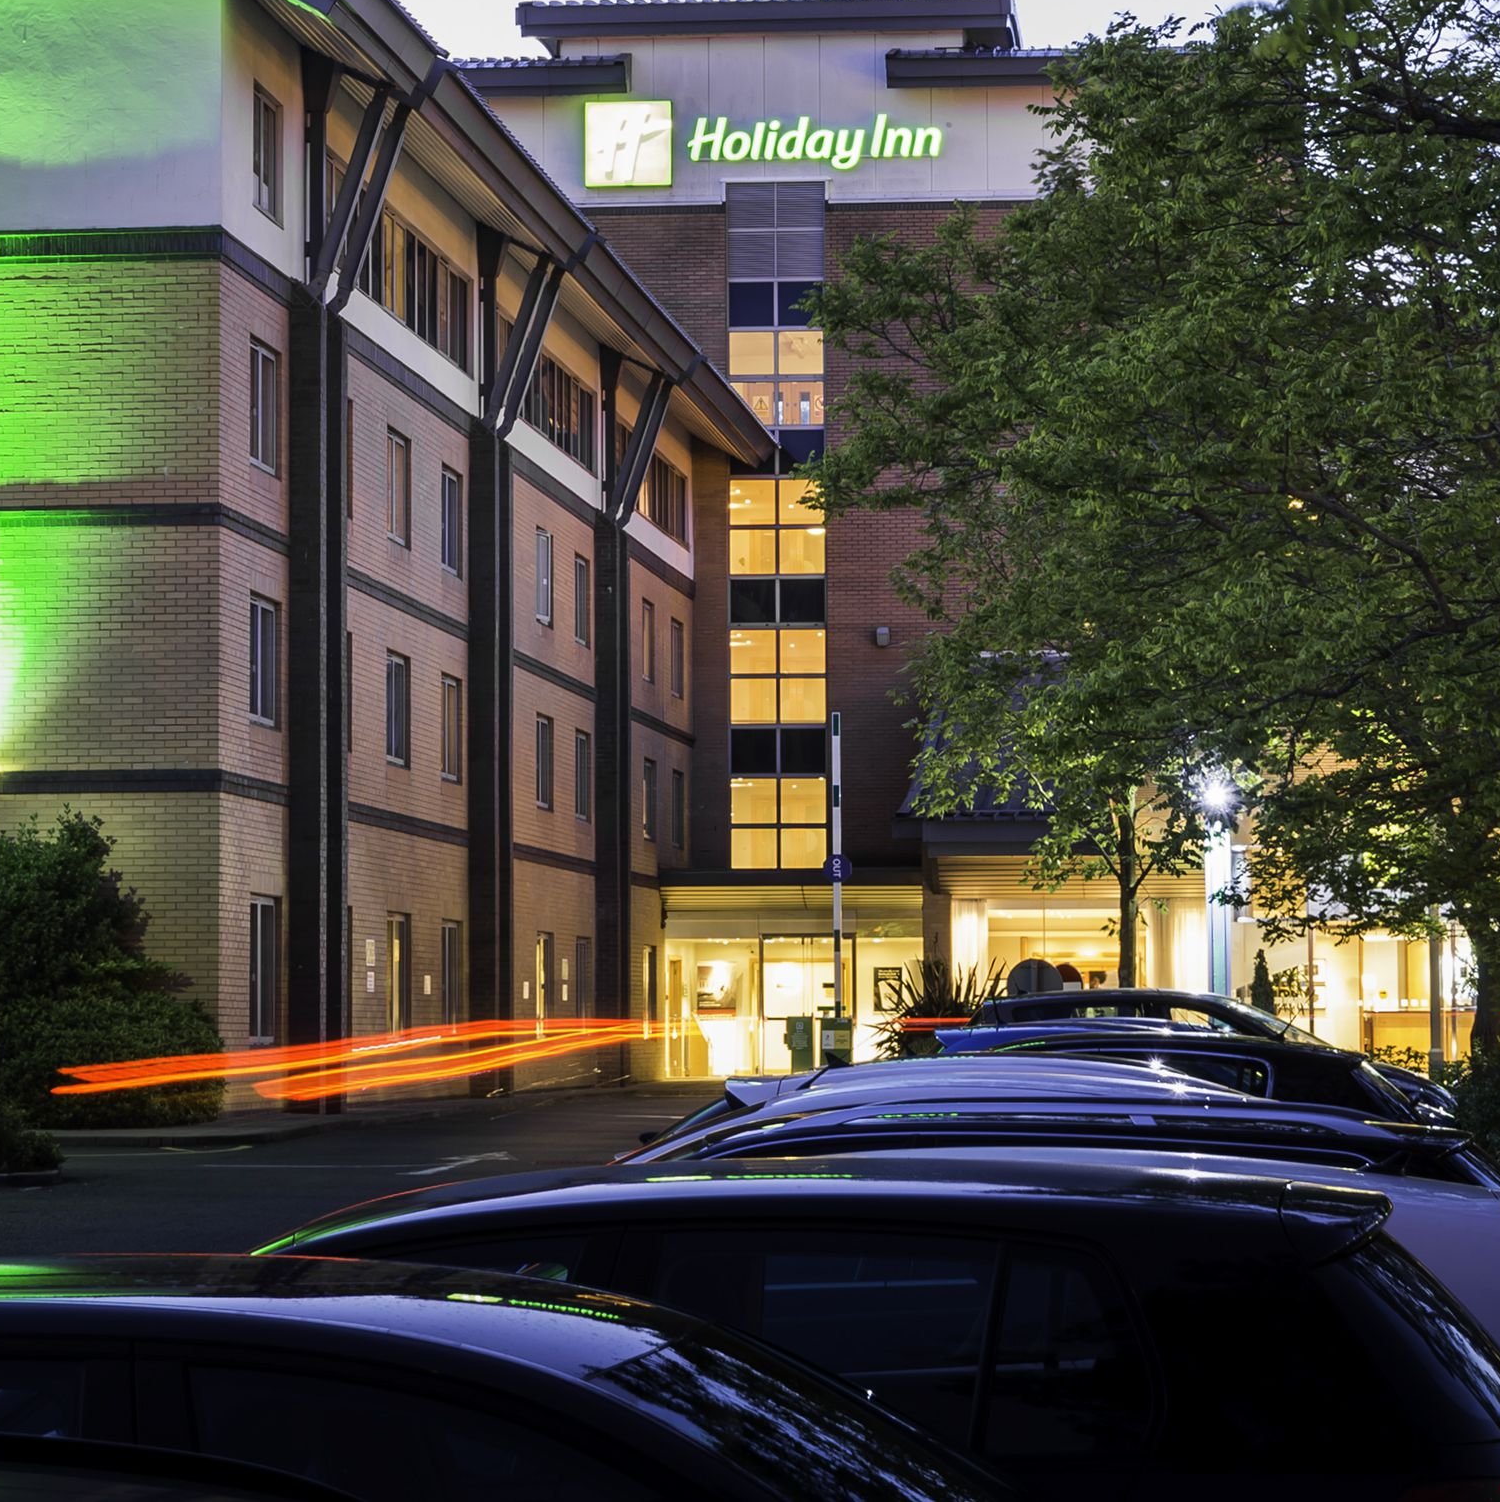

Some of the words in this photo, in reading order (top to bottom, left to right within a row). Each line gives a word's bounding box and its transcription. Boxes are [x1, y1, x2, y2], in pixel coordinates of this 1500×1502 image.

[687, 116, 865, 170] Holiday
[870, 113, 942, 158] Inn
[832, 858, 842, 878] OUT
